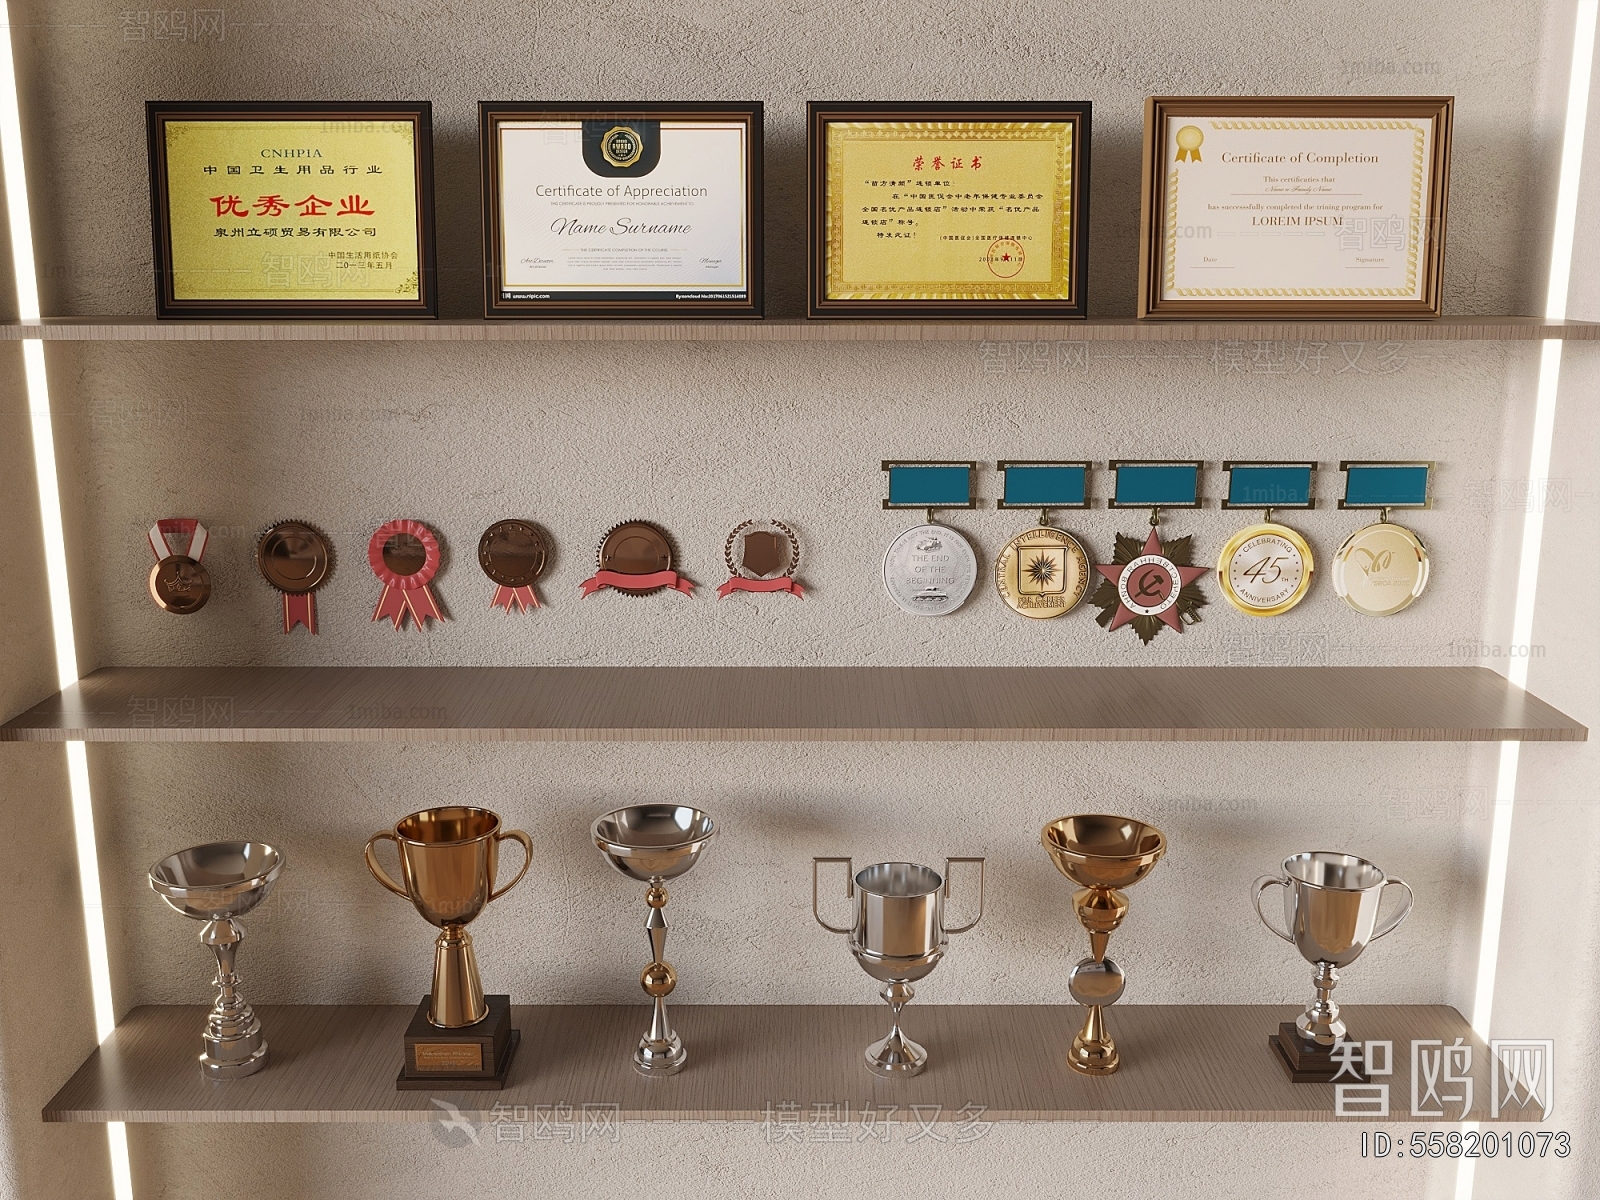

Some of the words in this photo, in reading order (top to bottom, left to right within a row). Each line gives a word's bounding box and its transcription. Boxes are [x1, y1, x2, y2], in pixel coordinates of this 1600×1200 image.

[261, 148, 323, 158] CNHPIA
[1221, 151, 1287, 164] Certificate
[1289, 151, 1304, 164] of
[1306, 151, 1379, 166] Completion
[912, 155, 983, 171] 荣誉证书
[203, 165, 383, 176] 中国卫生用品行业
[1262, 175, 1279, 183] This
[1321, 175, 1336, 183] that
[535, 184, 603, 197] Certificate
[606, 184, 621, 197] of
[623, 184, 708, 200] Appreciation
[209, 194, 376, 218] 优秀企业
[1207, 203, 1220, 211] has
[1266, 203, 1302, 212] completed
[1303, 203, 1314, 211] the
[1341, 204, 1372, 212] program
[1372, 203, 1383, 211] for
[550, 217, 608, 236] Name
[609, 217, 692, 236] Surname
[1252, 216, 1301, 227] LOREIM
[1304, 216, 1343, 227] IPSUM
[213, 227, 377, 238] 泉州立硕贸易有限公司
[1355, 256, 1385, 264] Signature
[1242, 537, 1293, 553] CELEBRATING
[911, 554, 929, 562] THE
[930, 554, 950, 563] END
[1009, 529, 1080, 554] INTELLIGENCE
[1073, 555, 1088, 598] AGENCY
[1243, 556, 1290, 584] 45
[905, 577, 956, 585] BEGINNING
[1240, 587, 1289, 604] ANNIVERSARY
